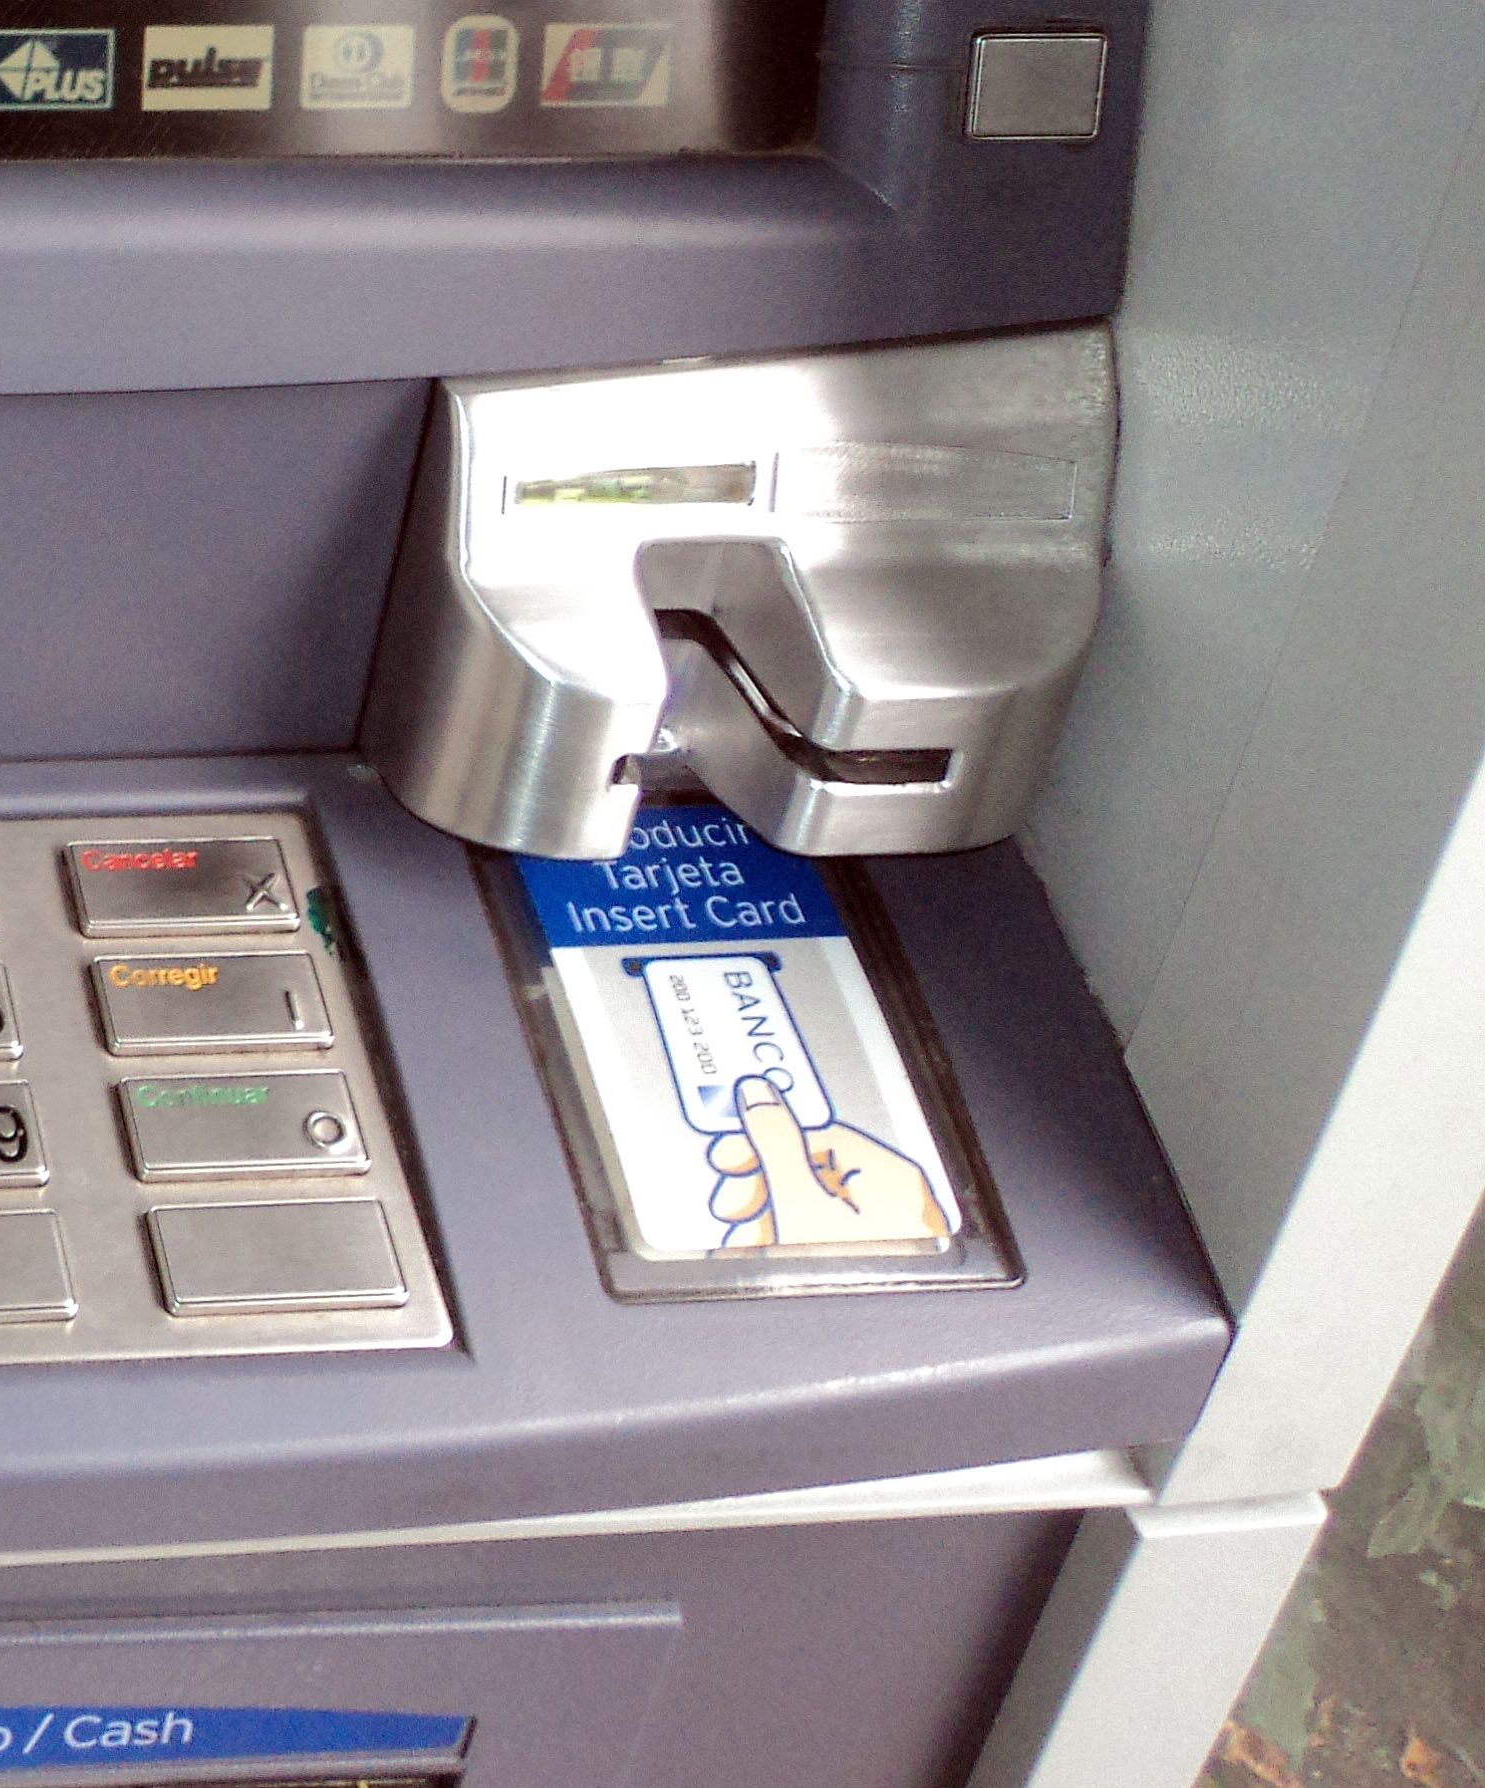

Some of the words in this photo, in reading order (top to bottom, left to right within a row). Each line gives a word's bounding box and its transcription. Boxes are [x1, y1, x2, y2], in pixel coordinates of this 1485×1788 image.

[22, 70, 108, 101] PLUS
[629, 817, 750, 850] oducir
[81, 849, 198, 872] Cancelar
[592, 856, 746, 894] Tarjeta
[566, 896, 697, 934] Insert
[705, 894, 806, 928] Card
[110, 963, 219, 990] Corregir
[22, 1714, 54, 1754] /
[63, 1713, 193, 1749] Cash
